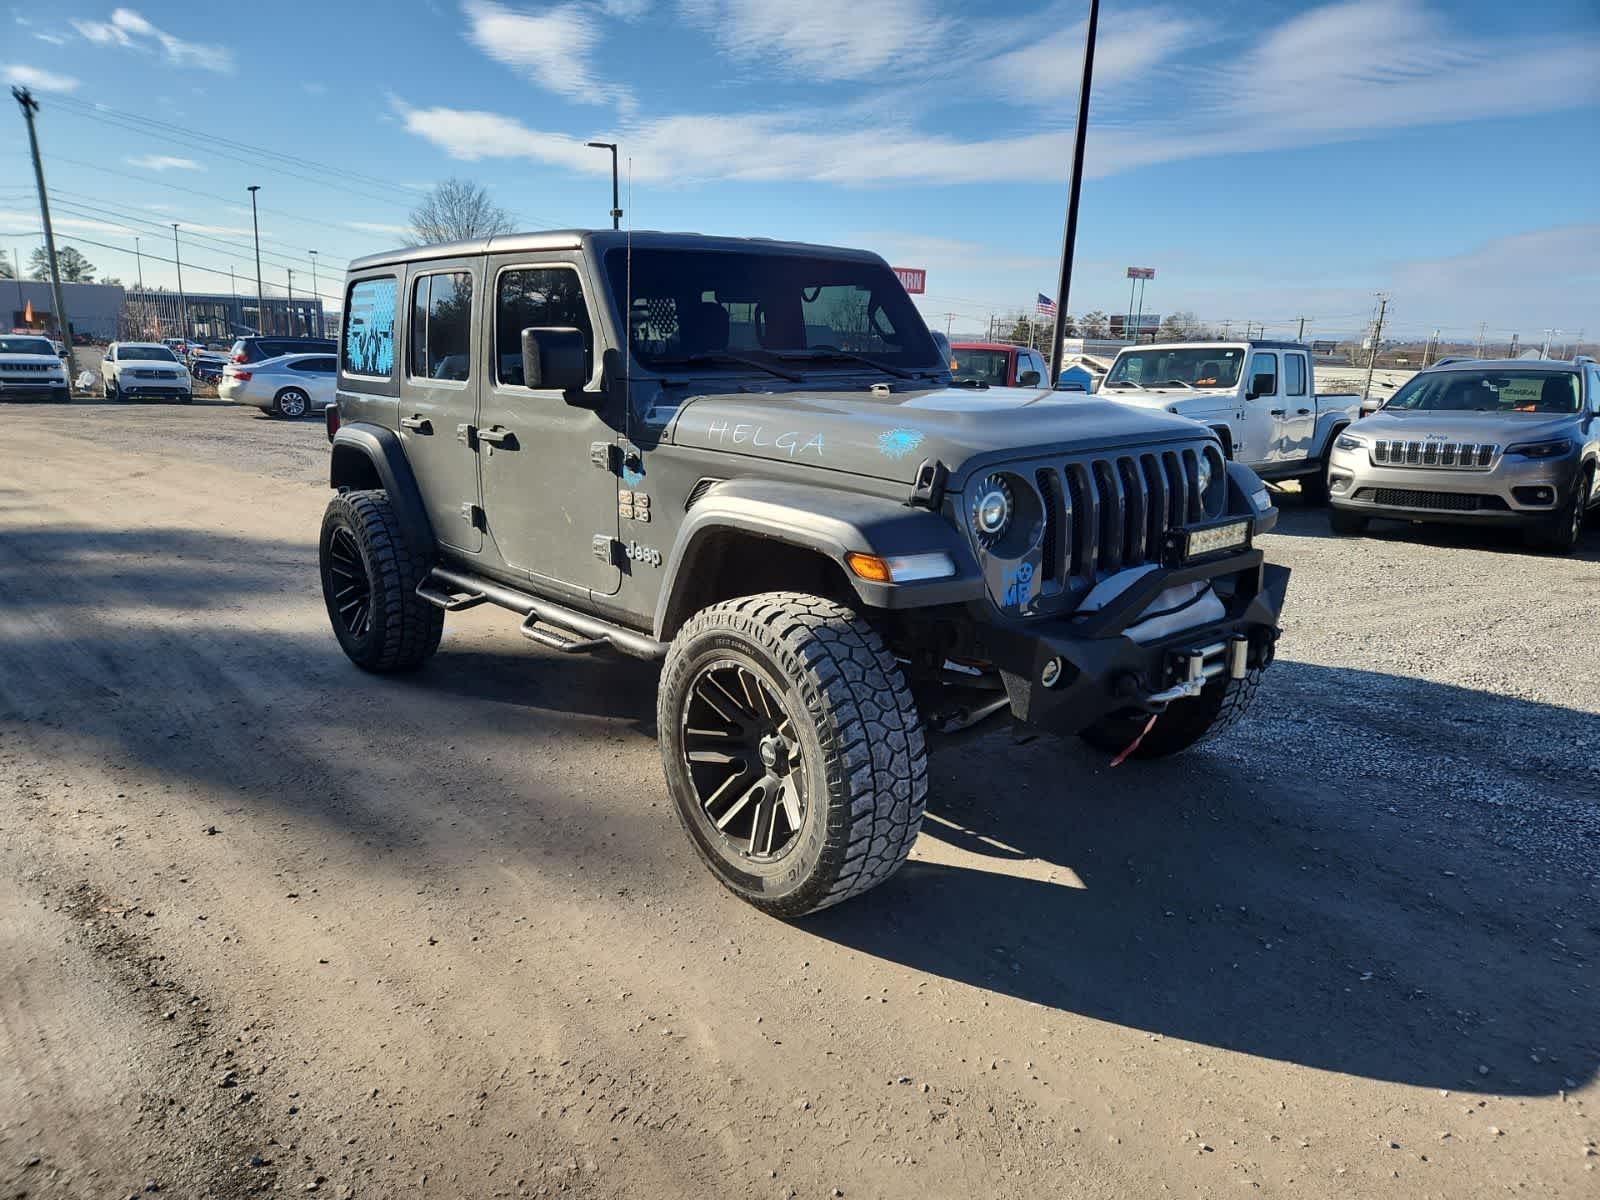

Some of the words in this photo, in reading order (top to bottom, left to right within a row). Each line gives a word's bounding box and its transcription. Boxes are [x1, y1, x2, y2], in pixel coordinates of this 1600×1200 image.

[895, 271, 922, 289] ARN
[708, 421, 824, 457] HELGA
[625, 540, 660, 568] Jeep
